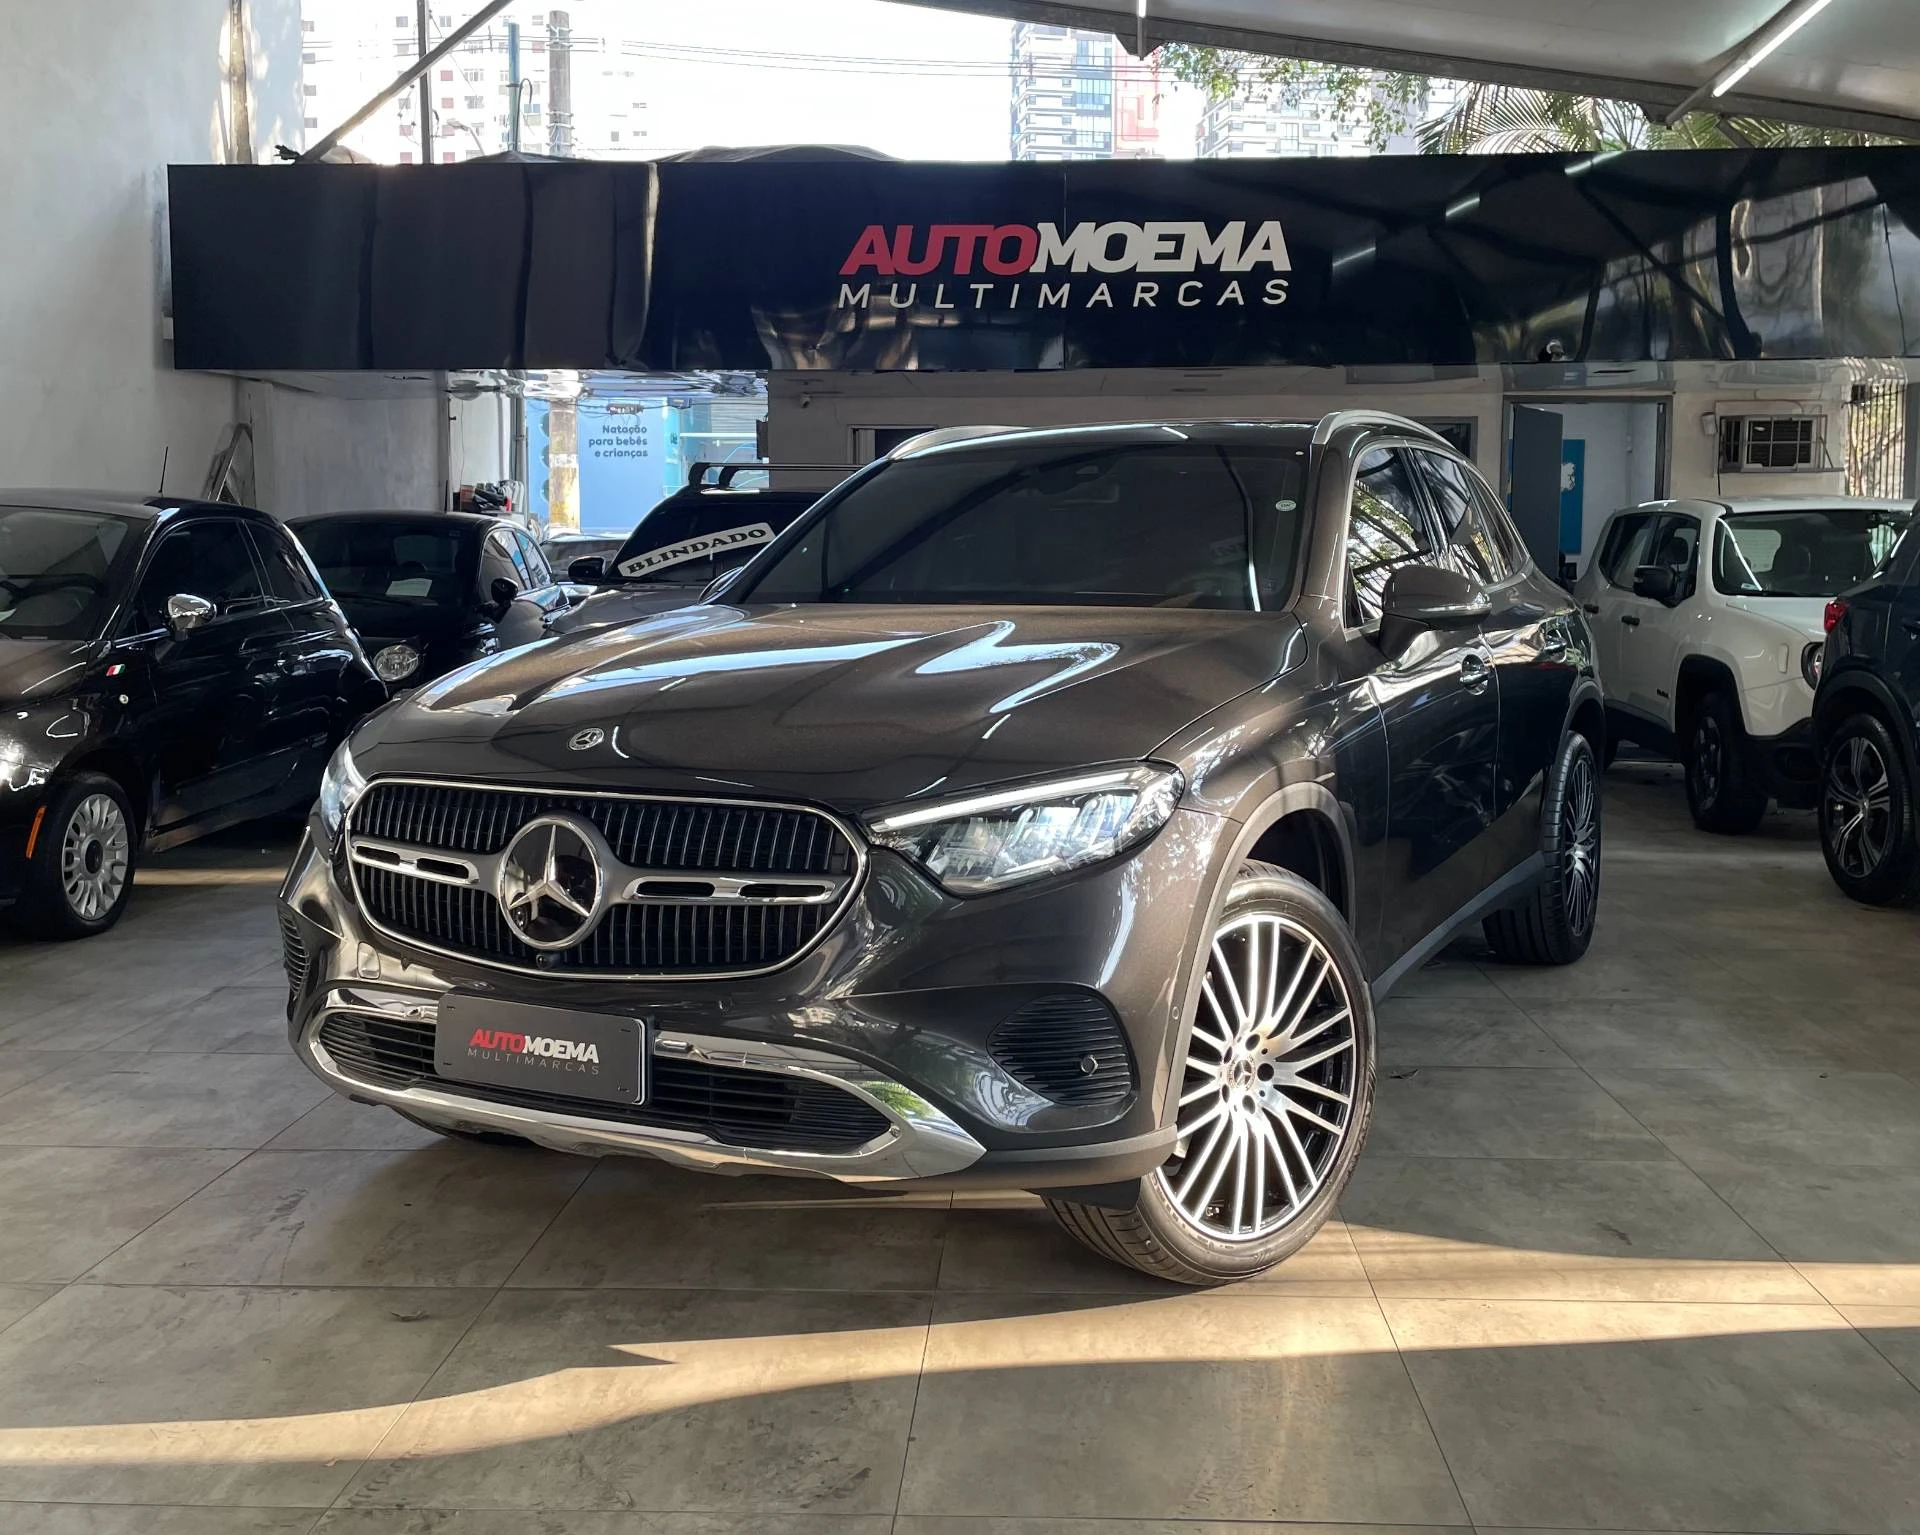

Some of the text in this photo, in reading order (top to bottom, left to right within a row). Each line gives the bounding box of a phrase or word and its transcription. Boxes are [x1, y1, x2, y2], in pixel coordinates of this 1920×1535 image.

[839, 221, 1292, 275] AUTOMOEMA
[838, 279, 1289, 308] MULTIMARCAS
[588, 436, 648, 448] para bebês
[602, 424, 648, 436] Natação
[594, 447, 649, 459] e crianças
[626, 529, 767, 575] BLINDADO
[468, 1028, 600, 1064] AUTOMOEMA
[467, 1047, 601, 1076] MULTIMARCAS
